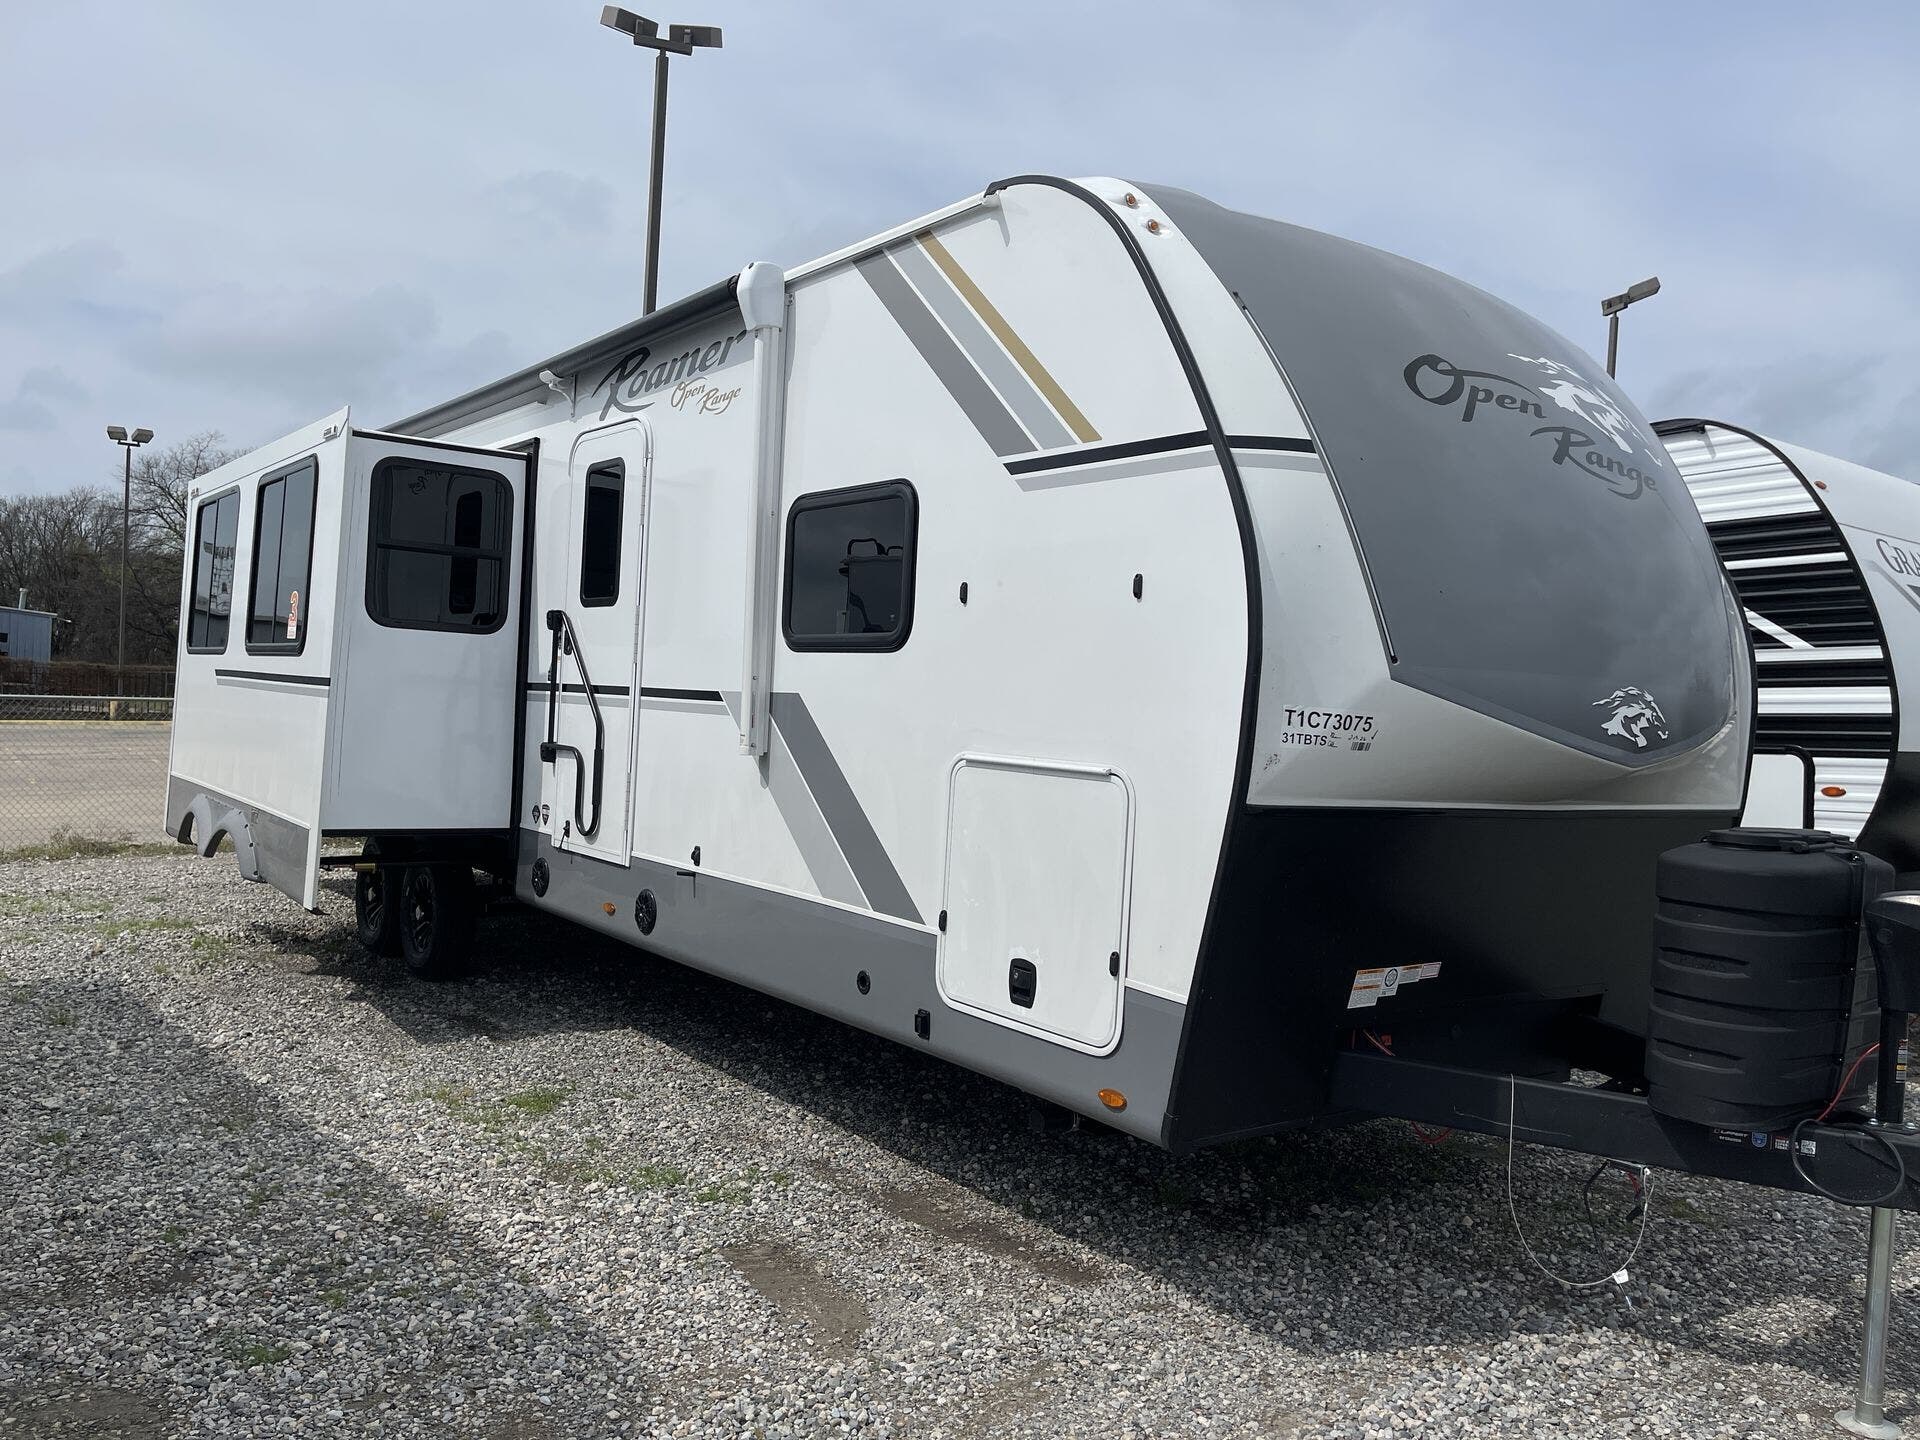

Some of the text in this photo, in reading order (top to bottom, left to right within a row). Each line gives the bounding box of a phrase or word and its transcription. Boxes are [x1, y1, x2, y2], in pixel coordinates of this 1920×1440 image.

[591, 329, 747, 421] Roamer
[670, 376, 708, 411] Open
[1403, 353, 1548, 422] Open
[696, 386, 742, 415] Range
[1529, 426, 1659, 500] Range
[1876, 538, 1920, 577] GRA
[1284, 708, 1374, 732] T1C73075
[1281, 732, 1328, 746] 31TBTS
